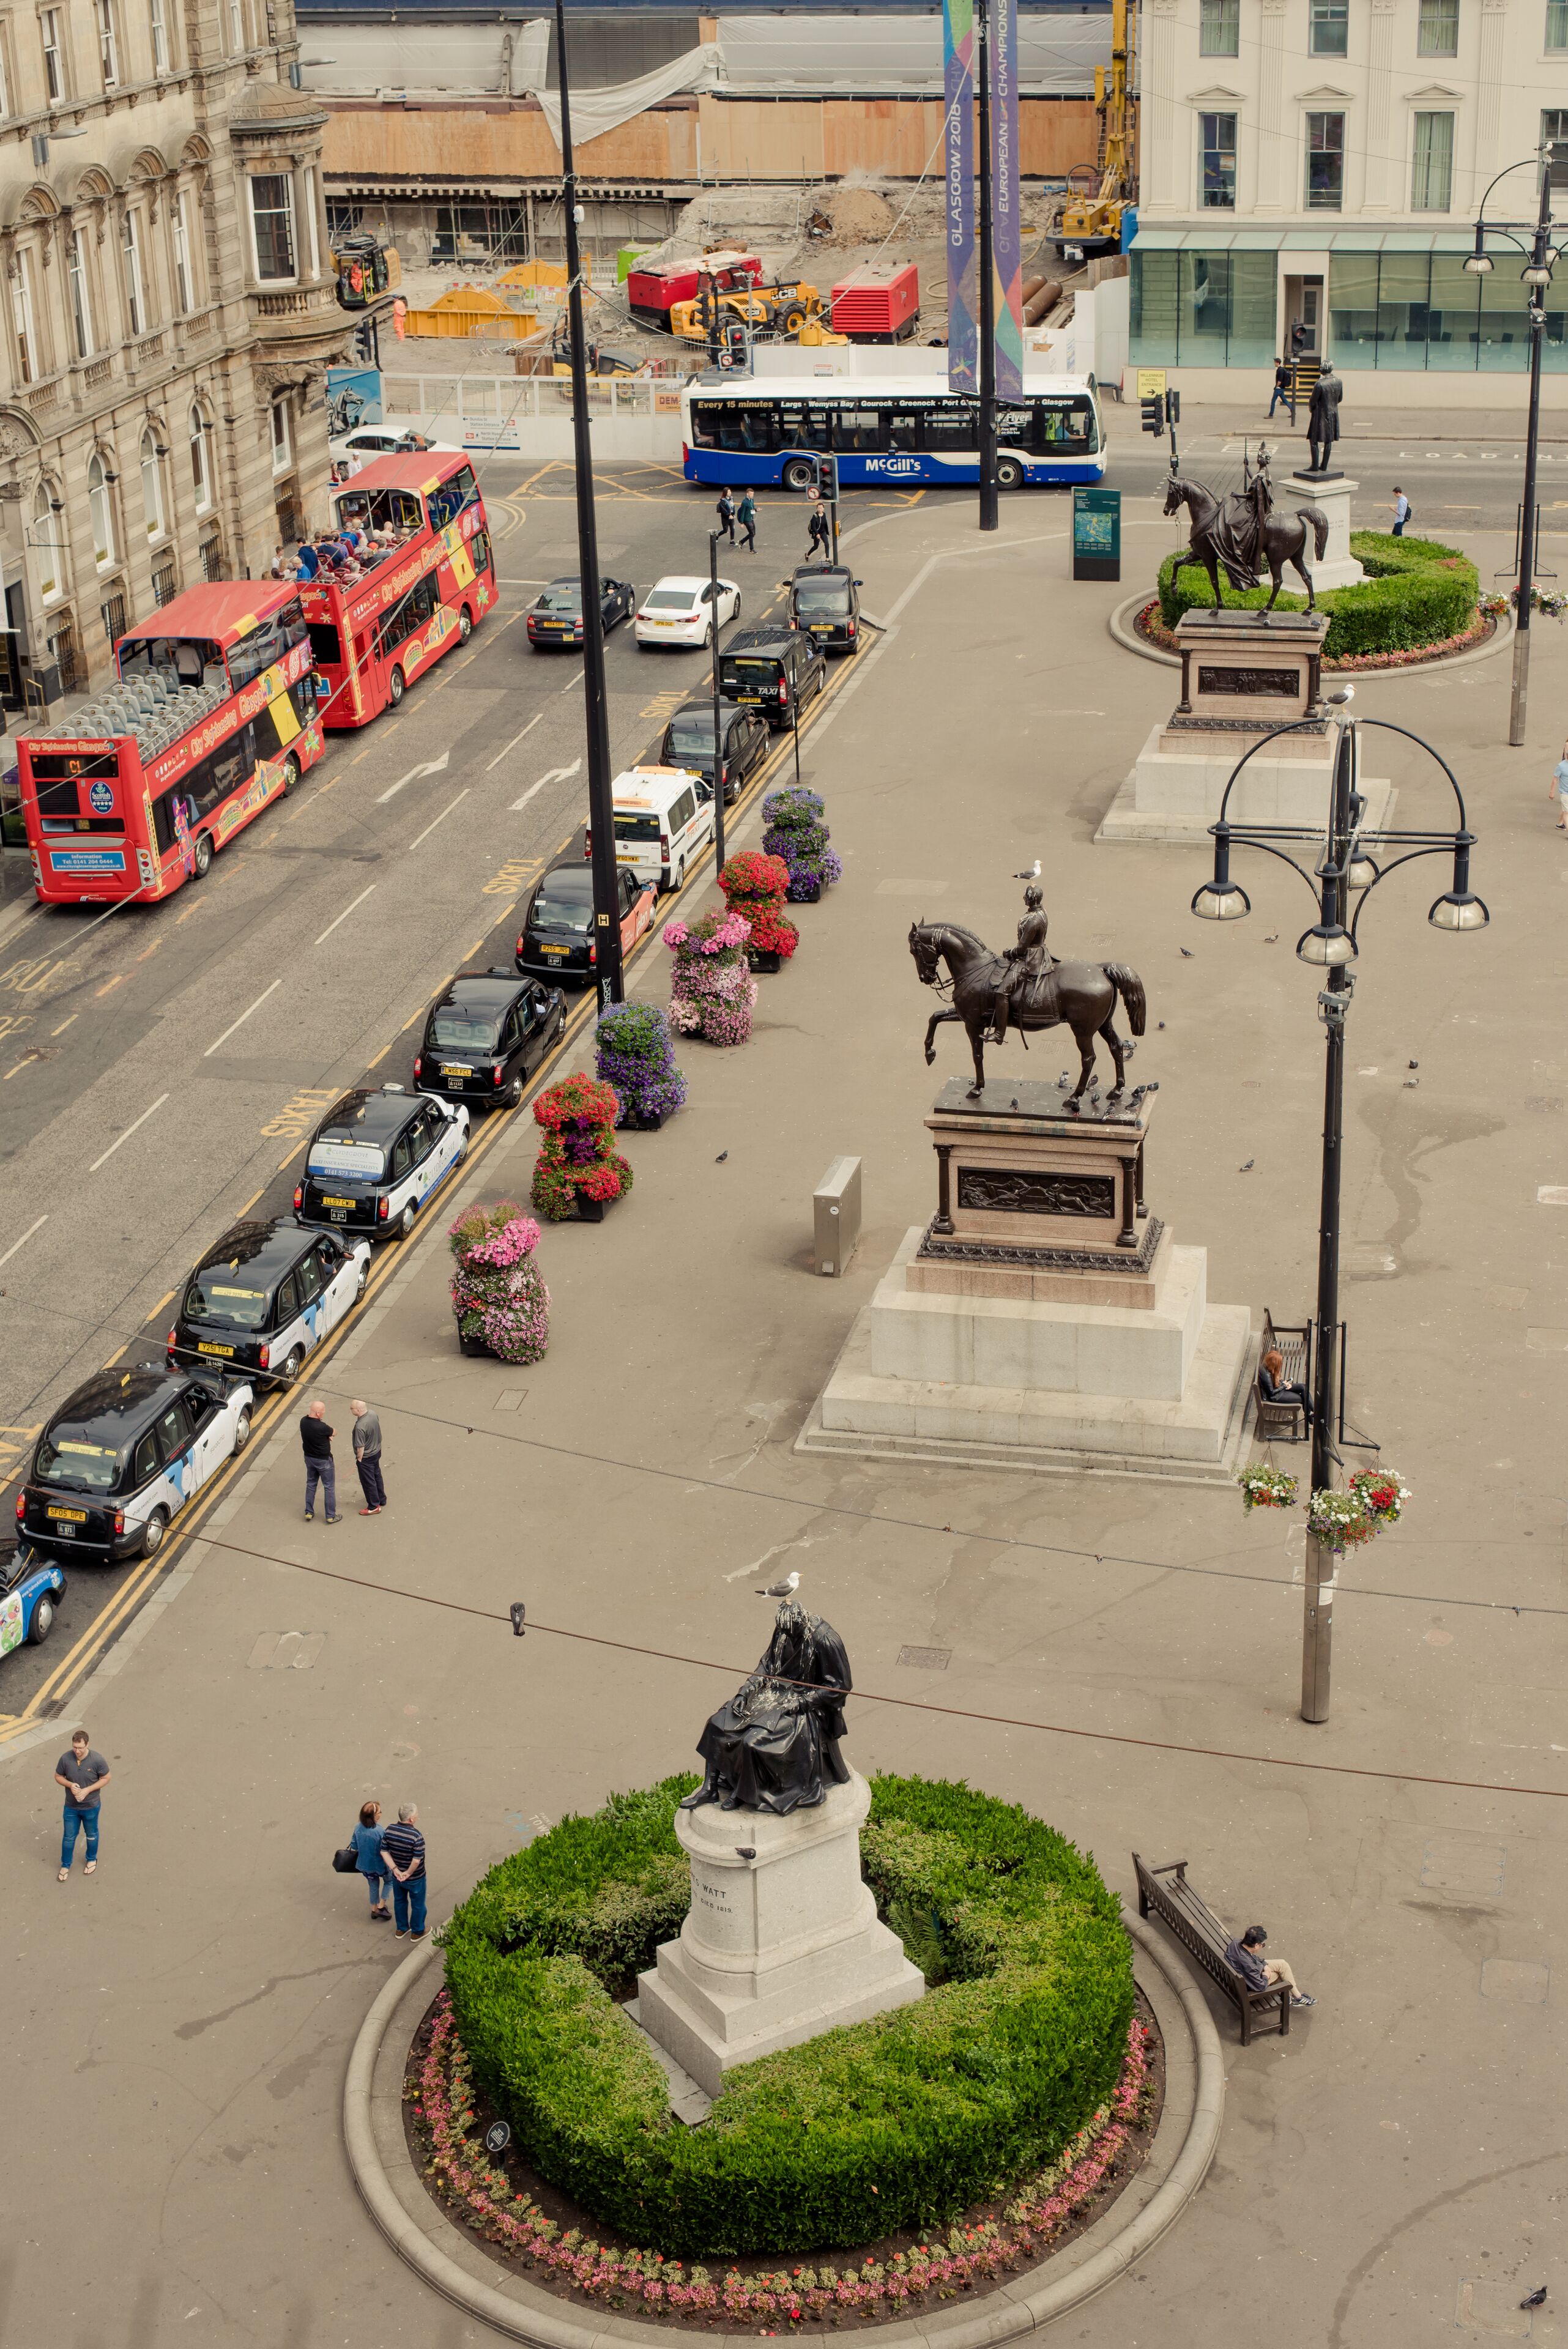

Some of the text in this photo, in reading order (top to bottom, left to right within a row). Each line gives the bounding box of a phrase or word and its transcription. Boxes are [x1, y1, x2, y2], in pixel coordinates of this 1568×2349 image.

[951, 104, 961, 145] 2018
[998, 124, 1009, 213] EUROPEAN
[951, 151, 962, 247] GLASGOW
[866, 459, 921, 471] McGill's
[382, 584, 393, 603] City
[392, 560, 422, 595] Sightseeing
[639, 690, 689, 718] TAXIS
[191, 736, 203, 758] City
[203, 709, 237, 748] Sightseeing
[239, 687, 267, 718] Glasgow
[29, 741, 110, 752] City Sightseeing Glasgow
[69, 760, 81, 773] C1
[482, 858, 544, 894] TAXIS
[600, 916, 608, 924] H
[260, 1088, 340, 1138] TAXIS
[50, 1508, 83, 1520] SF05 DPE
[700, 1898, 714, 1909] DIED
[702, 1883, 726, 1899] WATT
